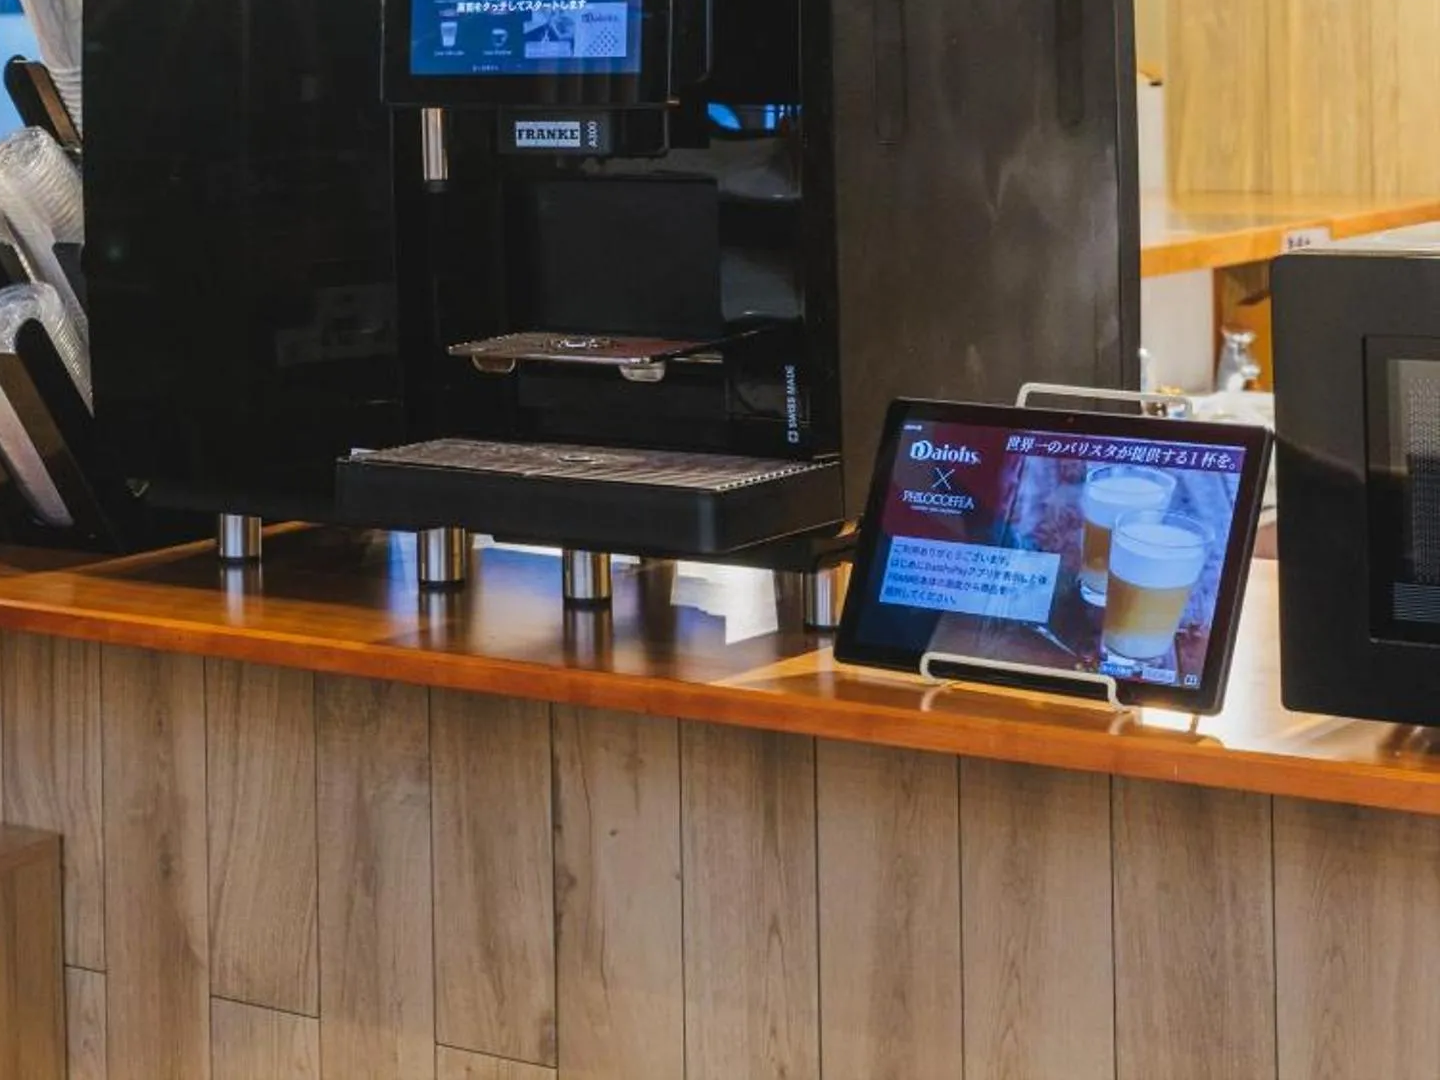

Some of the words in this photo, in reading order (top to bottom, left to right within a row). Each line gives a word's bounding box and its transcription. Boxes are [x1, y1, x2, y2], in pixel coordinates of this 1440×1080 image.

[517, 128, 579, 140] FRANKE
[785, 364, 796, 395] MADE
[910, 440, 981, 465] Daiohs
